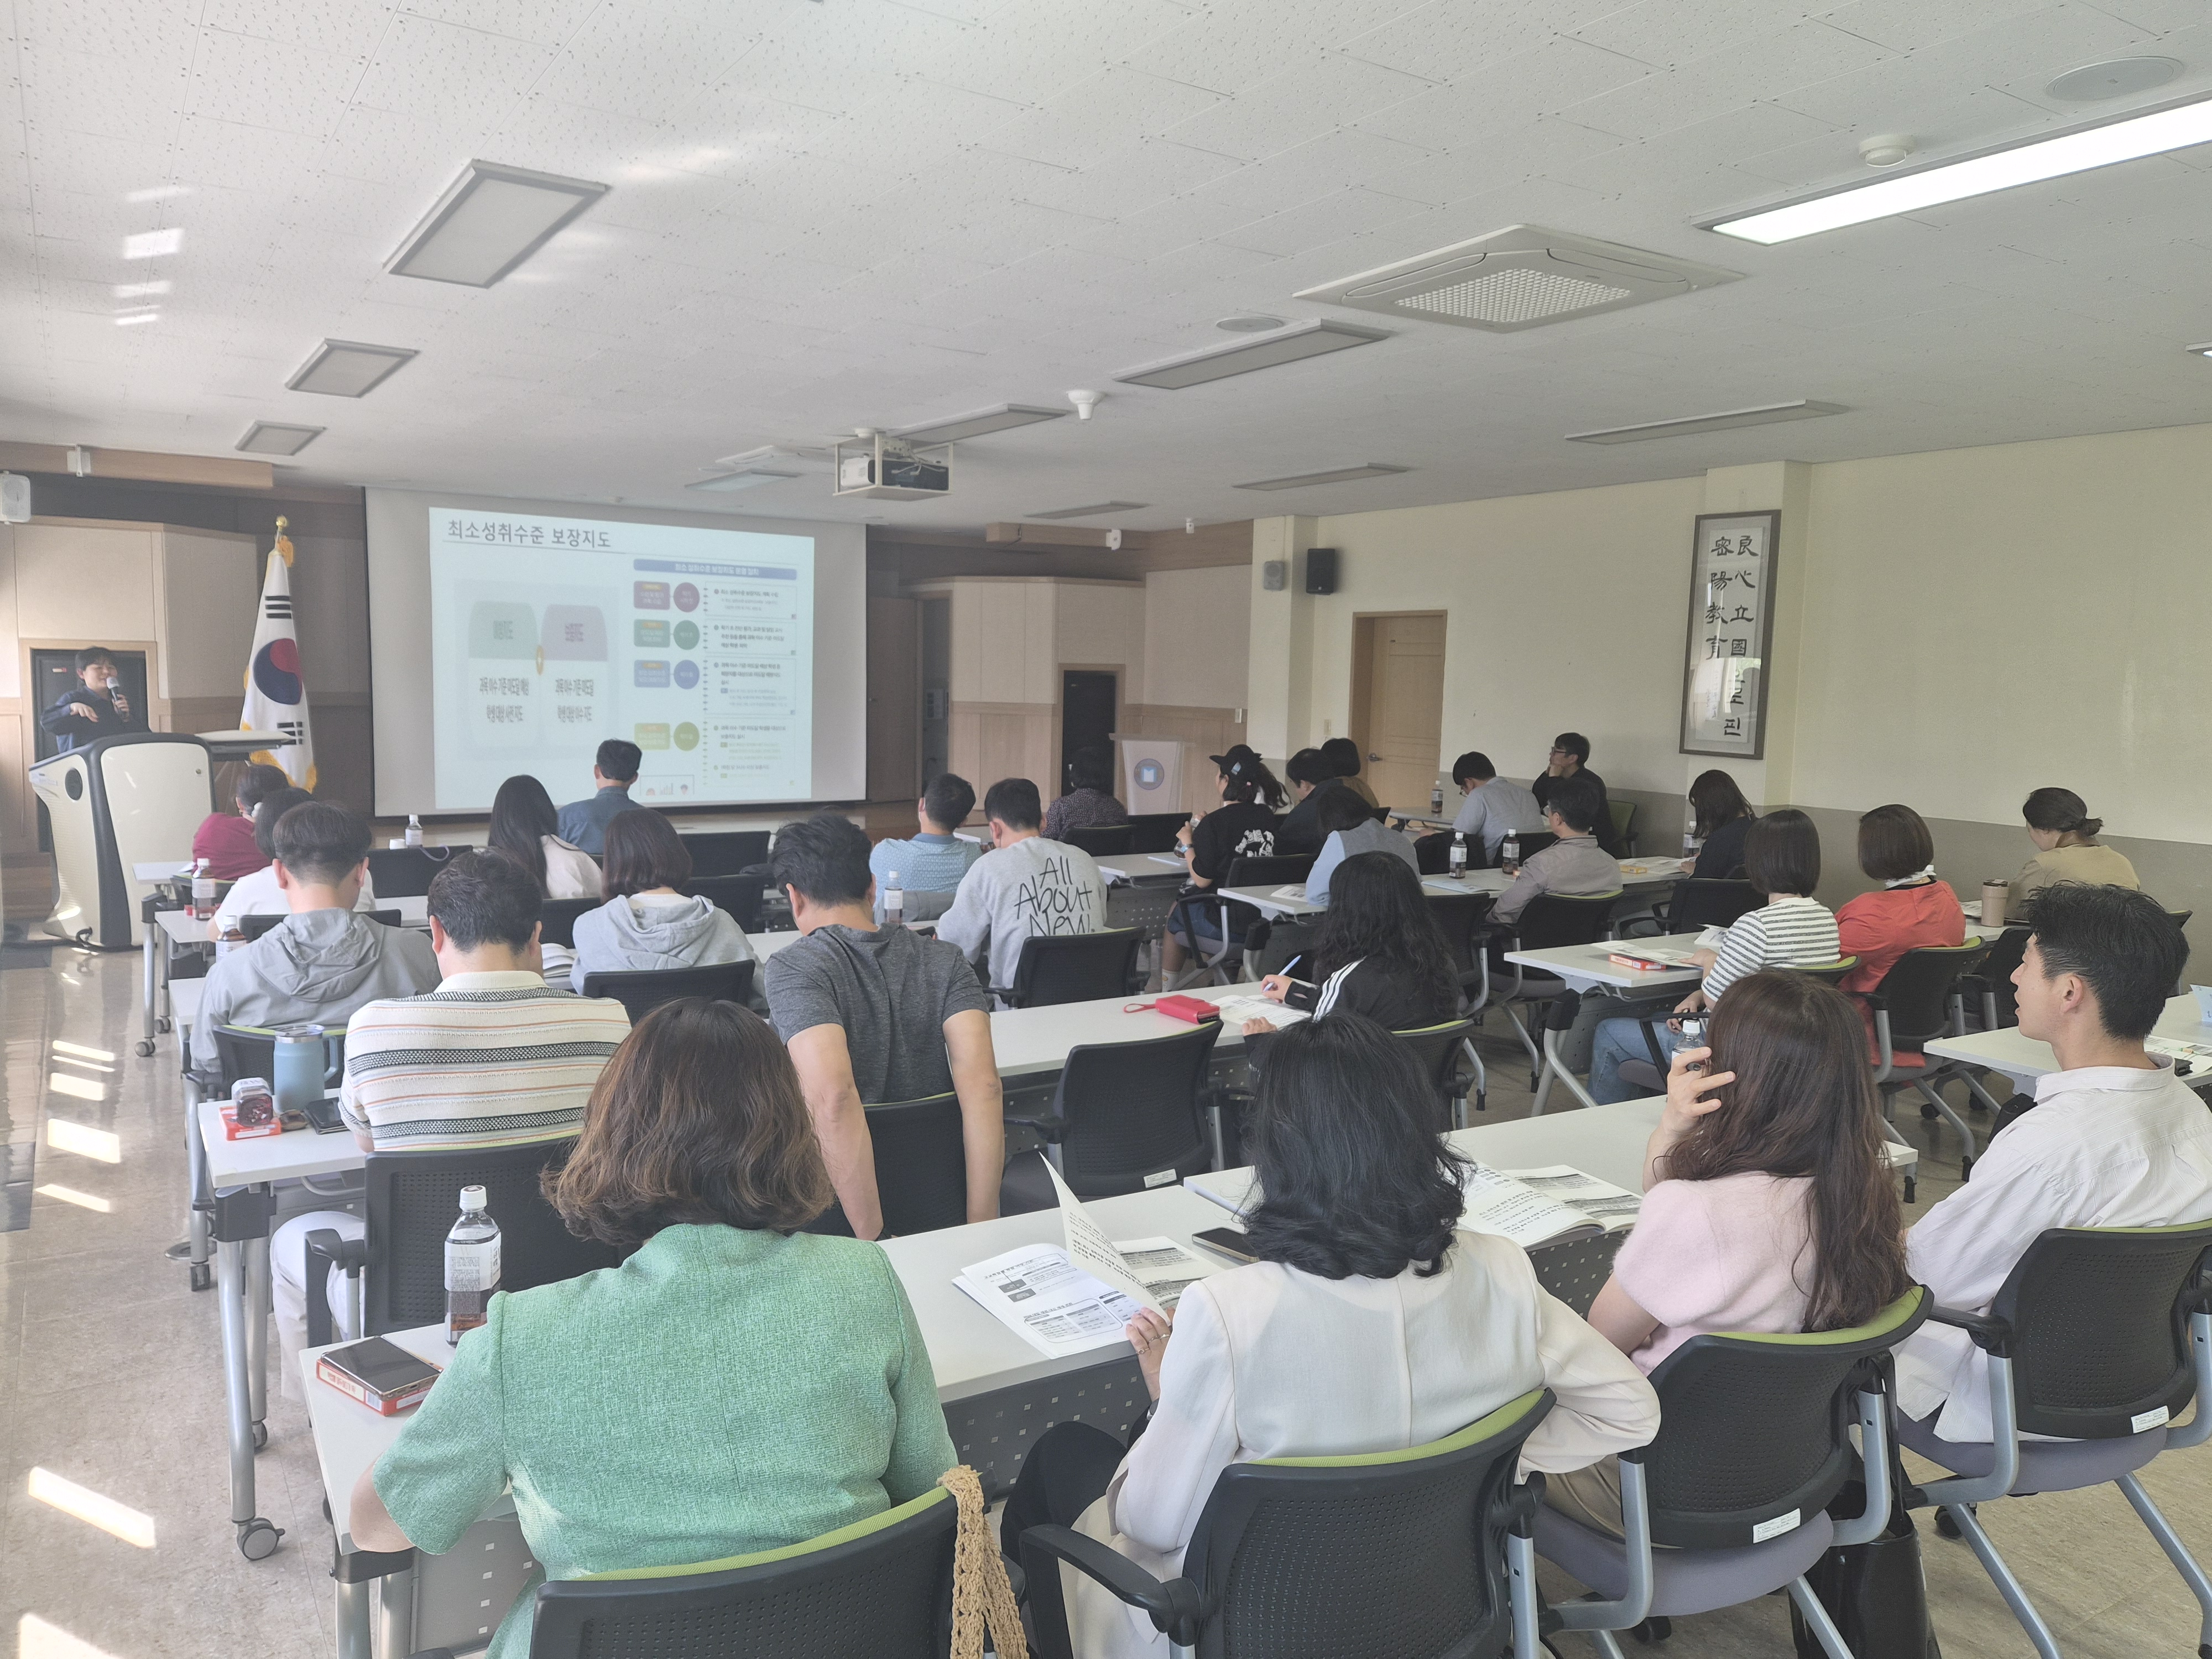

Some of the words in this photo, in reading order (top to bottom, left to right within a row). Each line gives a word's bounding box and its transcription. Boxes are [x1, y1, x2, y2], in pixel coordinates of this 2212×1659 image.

[448, 520, 544, 545] 최소성취수준
[552, 528, 611, 548] 보장지도
[1040, 855, 1072, 888] All
[1014, 875, 1092, 920] About
